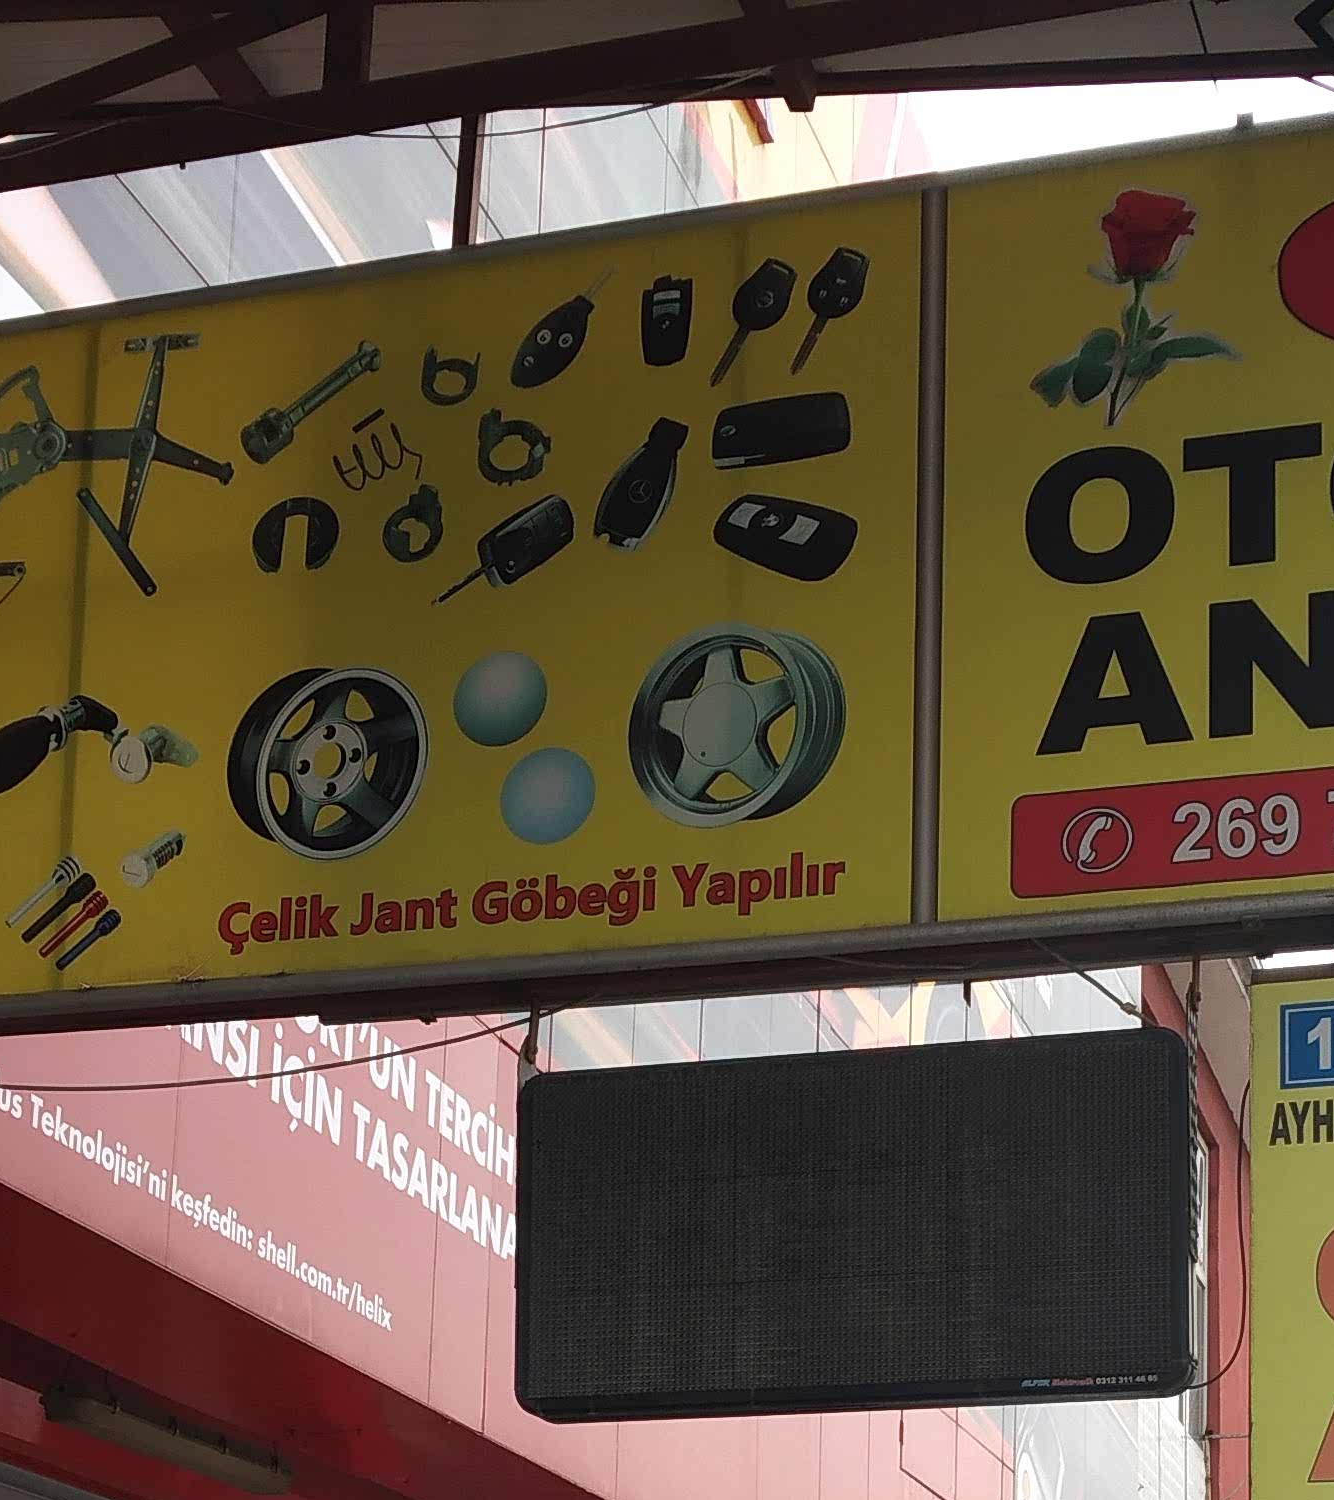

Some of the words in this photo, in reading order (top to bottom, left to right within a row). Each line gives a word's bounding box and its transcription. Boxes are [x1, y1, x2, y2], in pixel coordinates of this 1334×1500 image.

[1171, 791, 1301, 867] 269
[218, 893, 338, 954] Çelik
[349, 888, 457, 936] Jant
[471, 865, 655, 926] Göbeği
[672, 851, 845, 916] Yapılır
[271, 1022, 342, 1146] İÇİN
[171, 1175, 253, 1251] keşfedin:
[258, 1230, 393, 1331] shell.com.tr/helix
